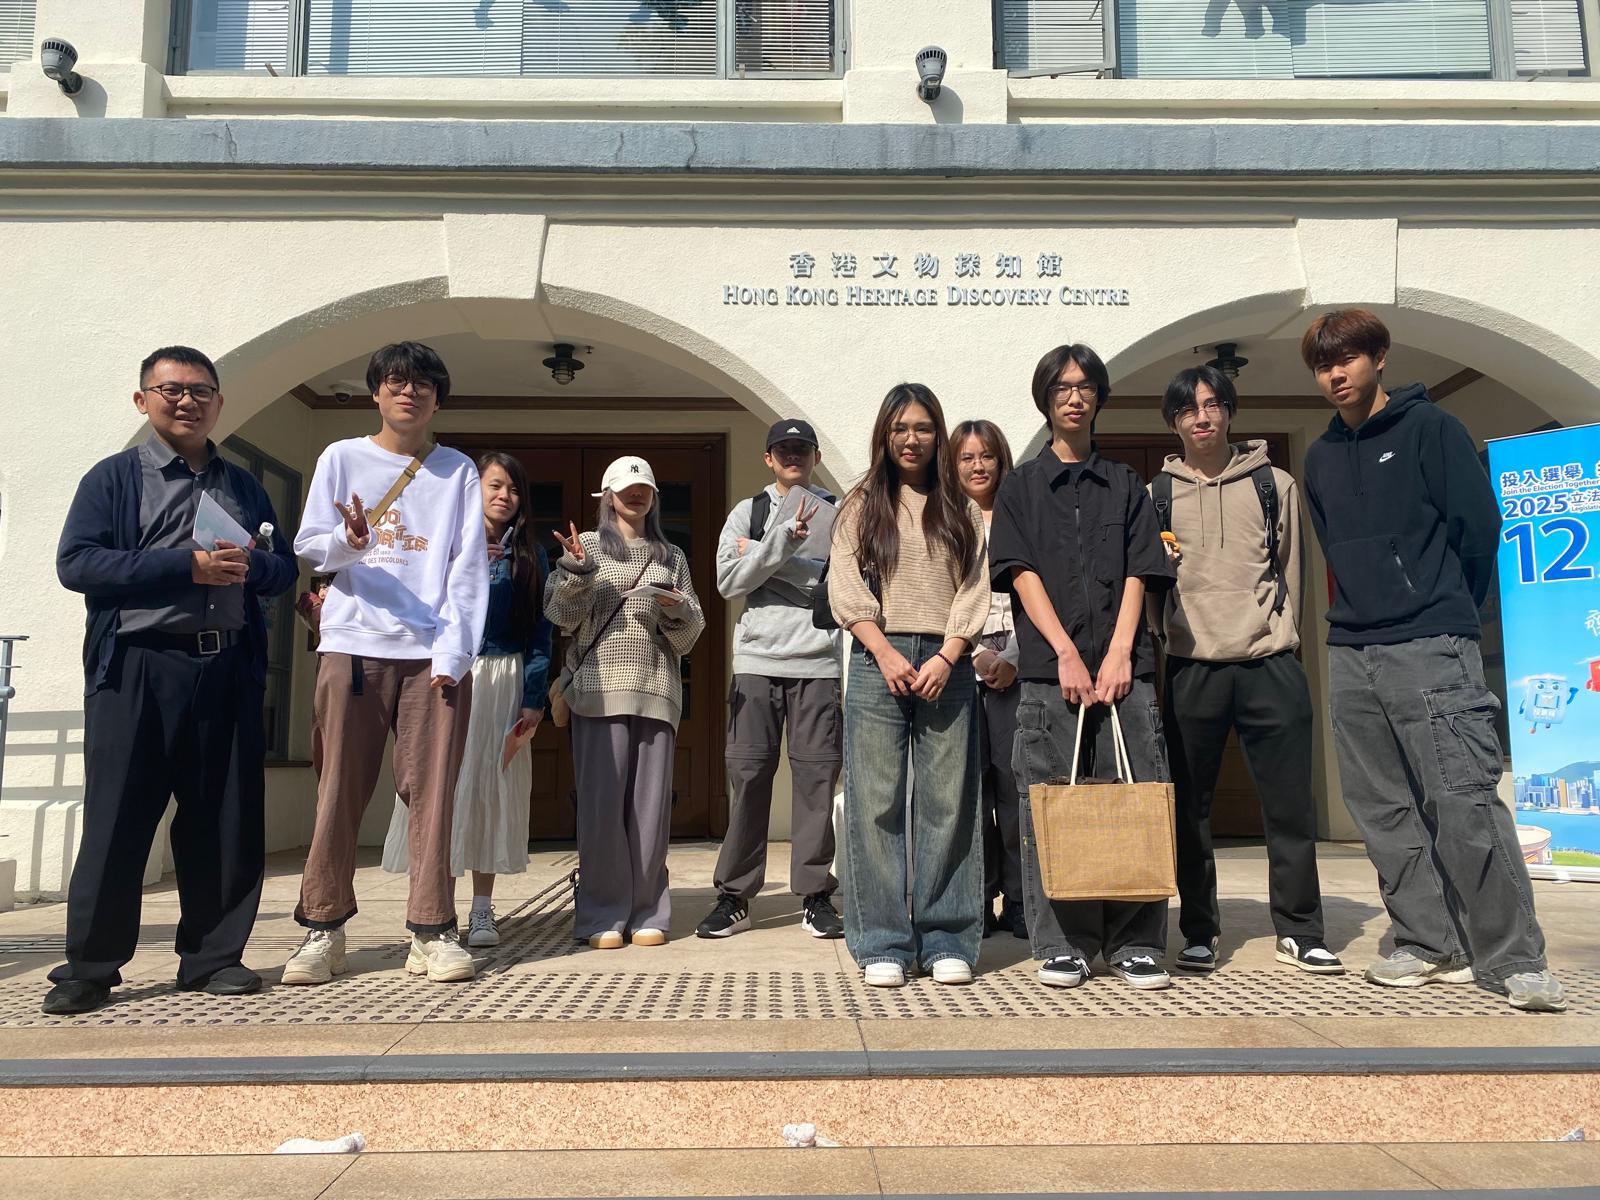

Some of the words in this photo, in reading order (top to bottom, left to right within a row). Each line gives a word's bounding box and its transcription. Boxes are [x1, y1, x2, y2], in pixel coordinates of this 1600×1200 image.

[789, 251, 1063, 278] 香港文物探知館
[723, 284, 779, 305] HONG
[785, 285, 839, 305] KONG
[846, 285, 938, 305] HERITAGE
[946, 285, 1051, 306] DISCOVERY
[1058, 286, 1130, 306] CENTRE
[1501, 464, 1581, 488] 投入選舉
[1502, 488, 1518, 496] Join
[1533, 482, 1564, 492] Election
[1565, 479, 1600, 489] Together
[1504, 493, 1569, 518] 2025
